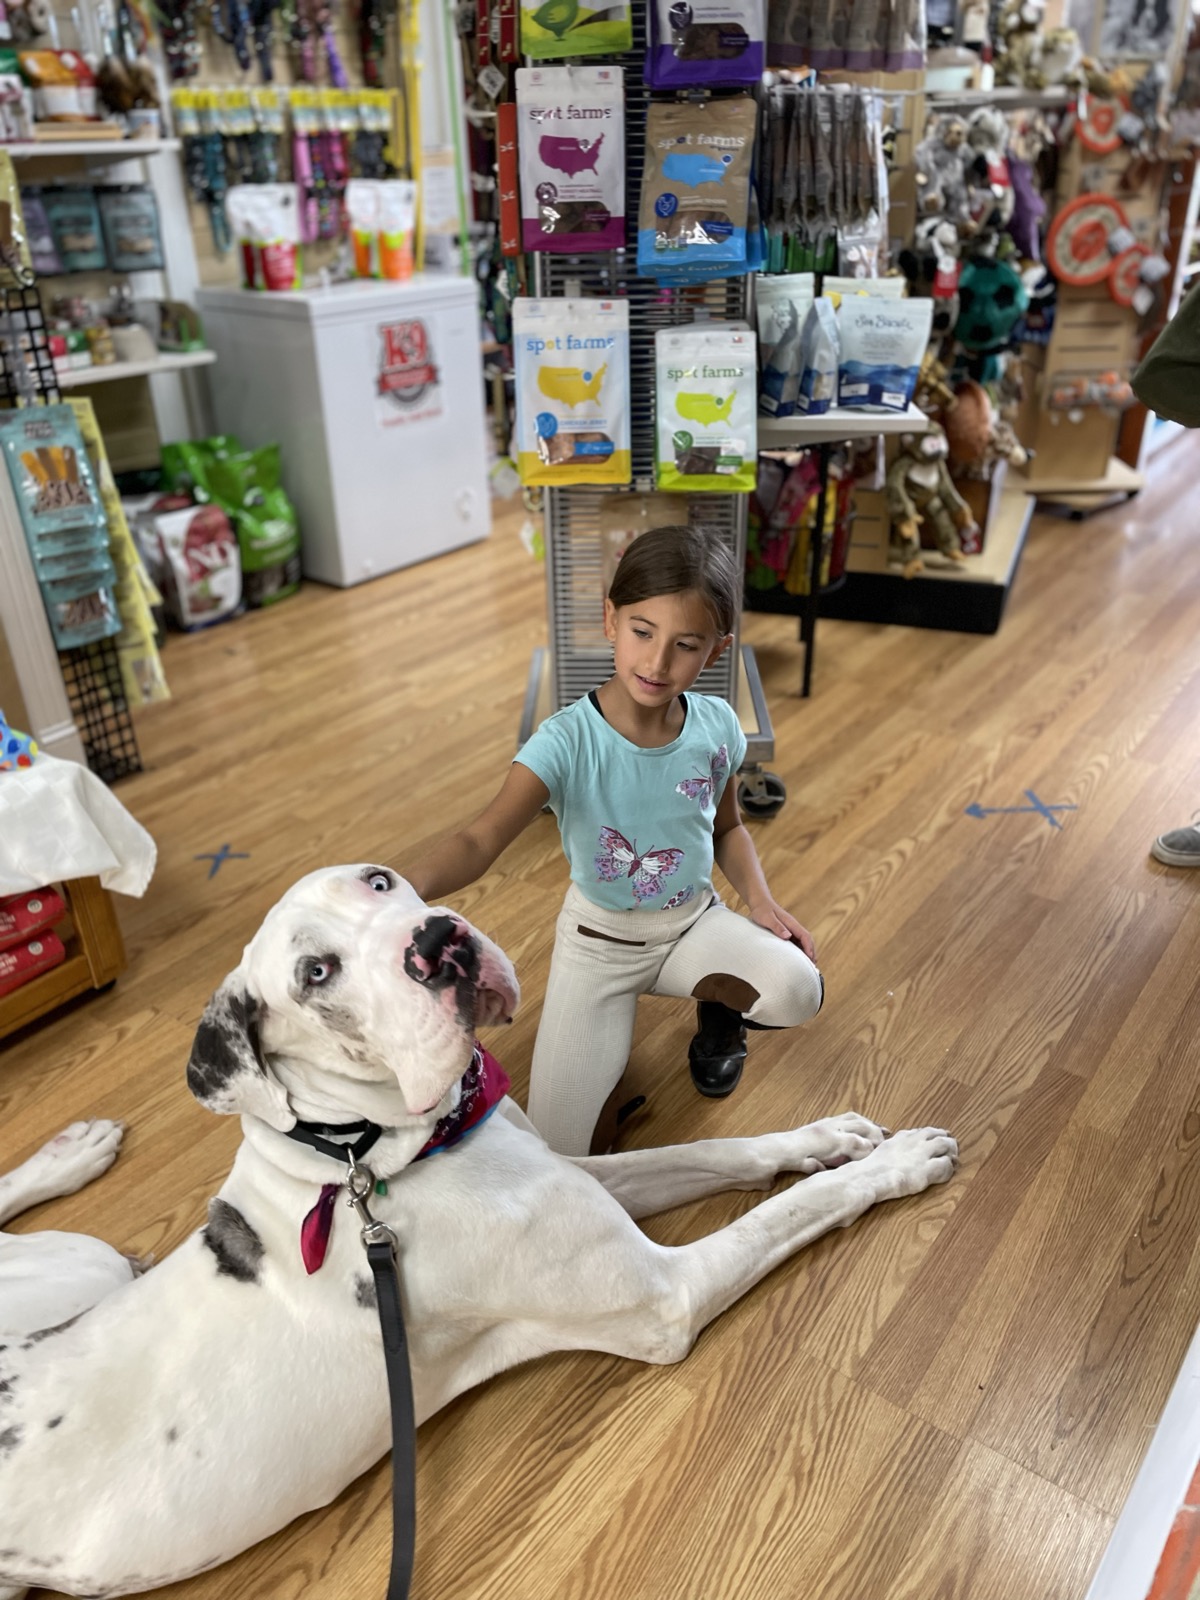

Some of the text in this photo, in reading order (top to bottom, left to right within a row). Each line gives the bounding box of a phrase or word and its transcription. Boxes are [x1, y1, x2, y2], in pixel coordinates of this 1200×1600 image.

[567, 104, 612, 119] farms
[657, 133, 745, 150] spot farms
[526, 334, 614, 356] spot farms
[702, 365, 744, 378] farms
